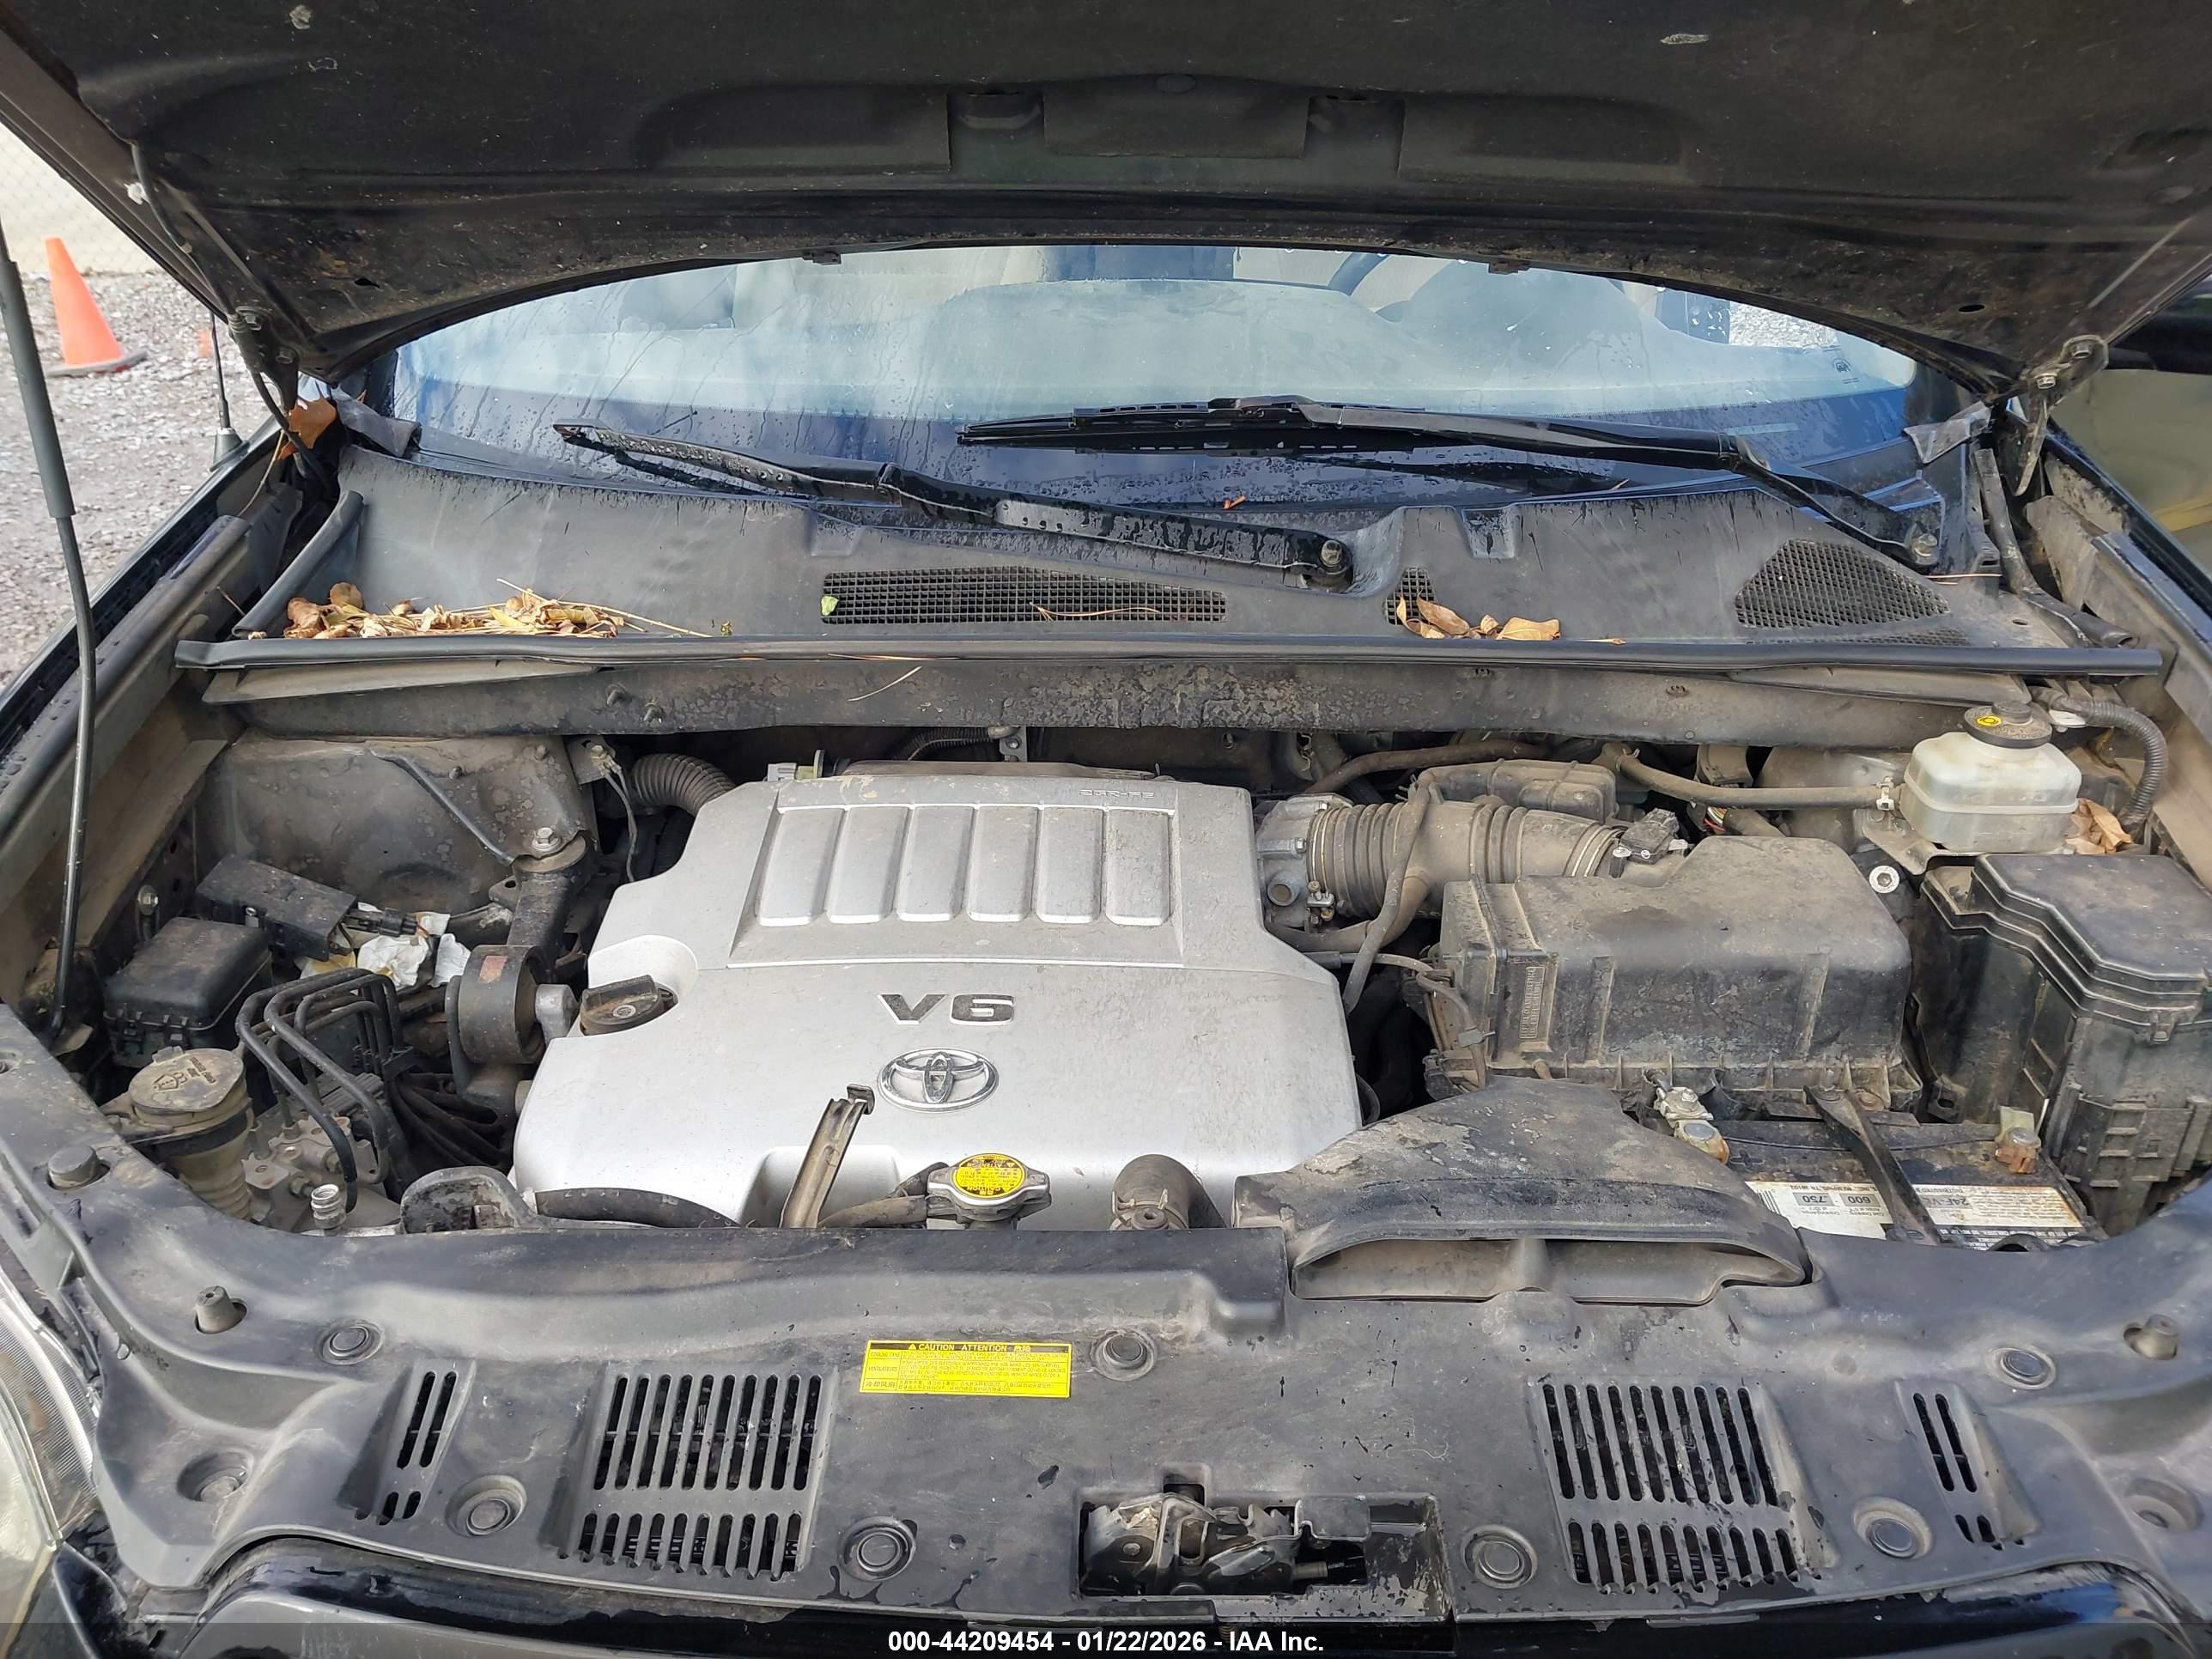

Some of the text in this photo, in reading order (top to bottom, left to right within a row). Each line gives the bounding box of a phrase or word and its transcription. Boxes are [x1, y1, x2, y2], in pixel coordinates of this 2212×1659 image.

[878, 994, 1015, 1026] V6
[1802, 1194, 1827, 1203] 750
[1848, 1195, 1872, 1204] 600
